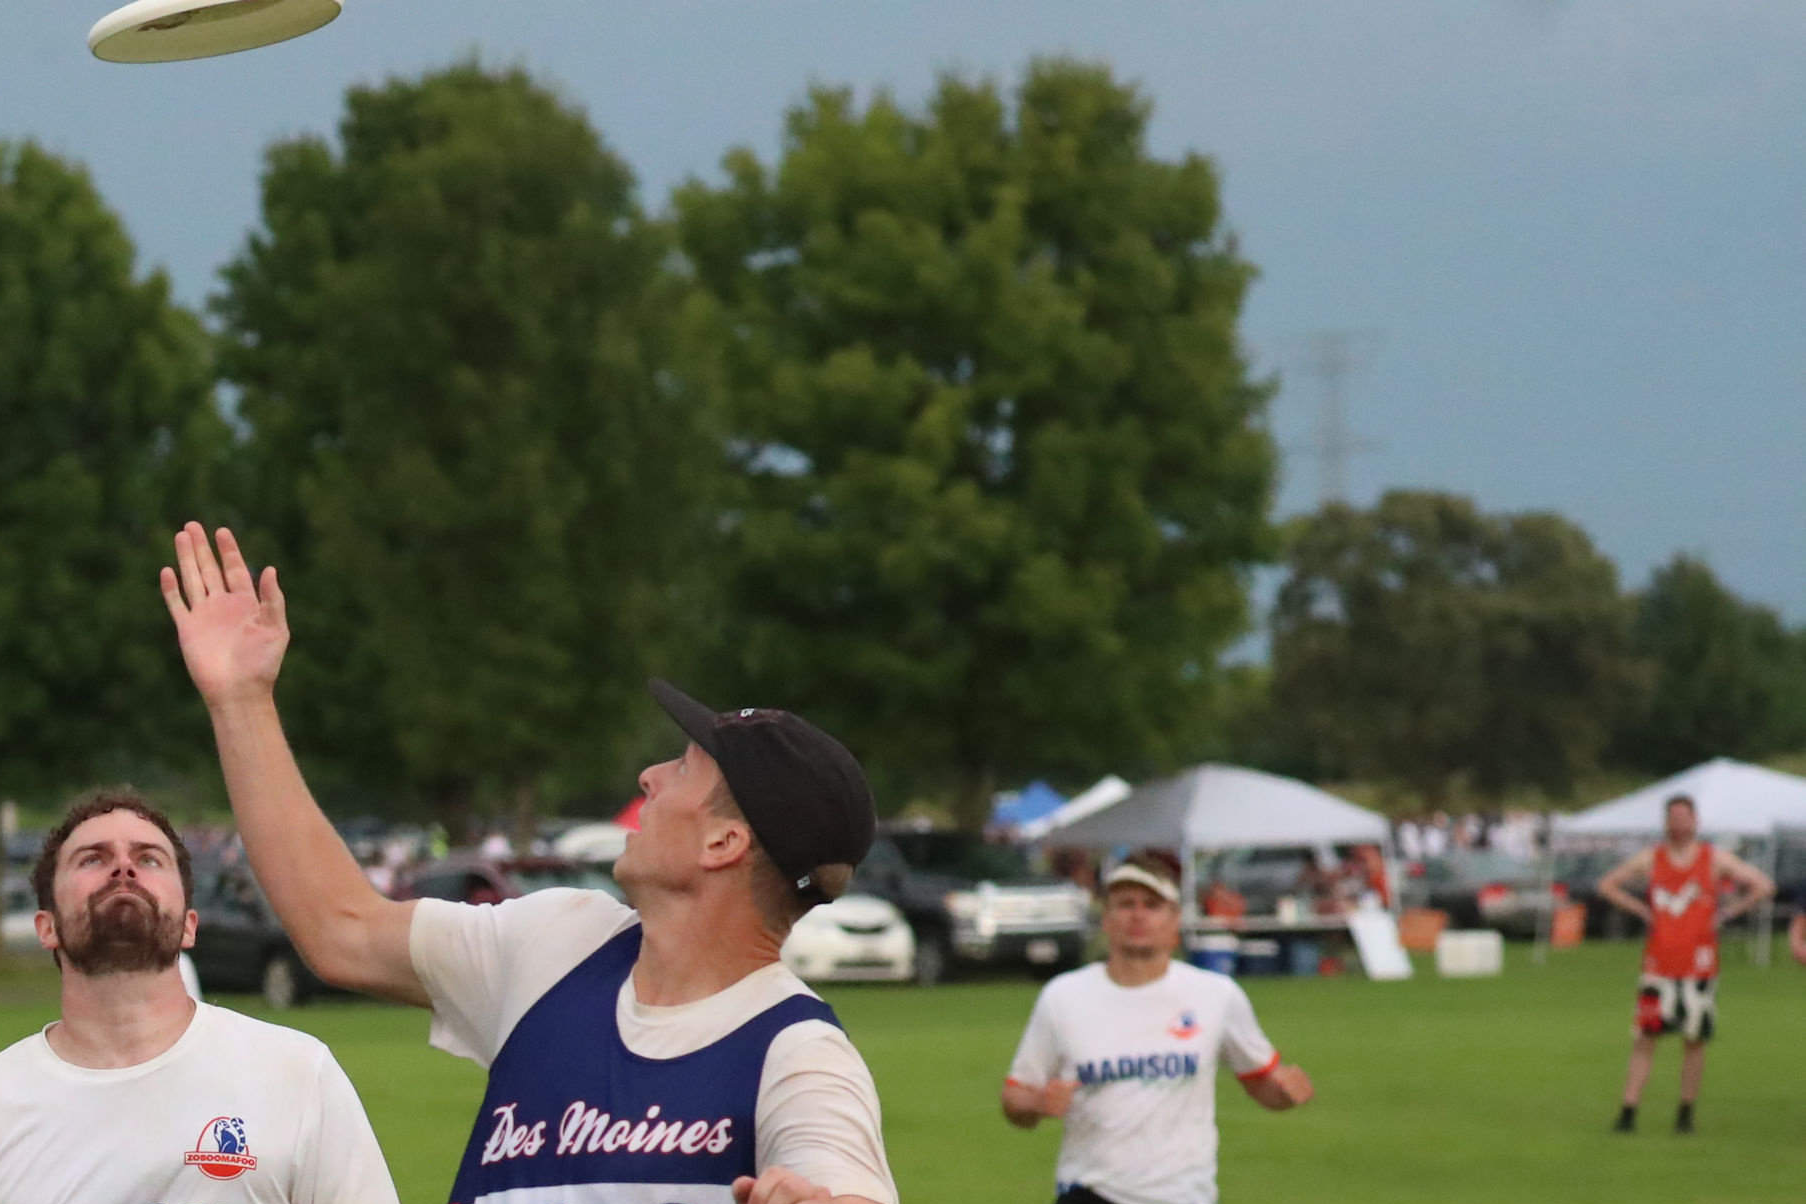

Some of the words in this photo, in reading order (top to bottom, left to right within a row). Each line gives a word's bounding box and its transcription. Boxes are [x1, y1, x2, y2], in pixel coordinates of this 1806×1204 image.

[1076, 1053, 1199, 1085] MADISON
[481, 1102, 547, 1166] Des
[555, 1100, 734, 1155] Moines
[186, 1154, 256, 1167] ZOBOOMAFOO
